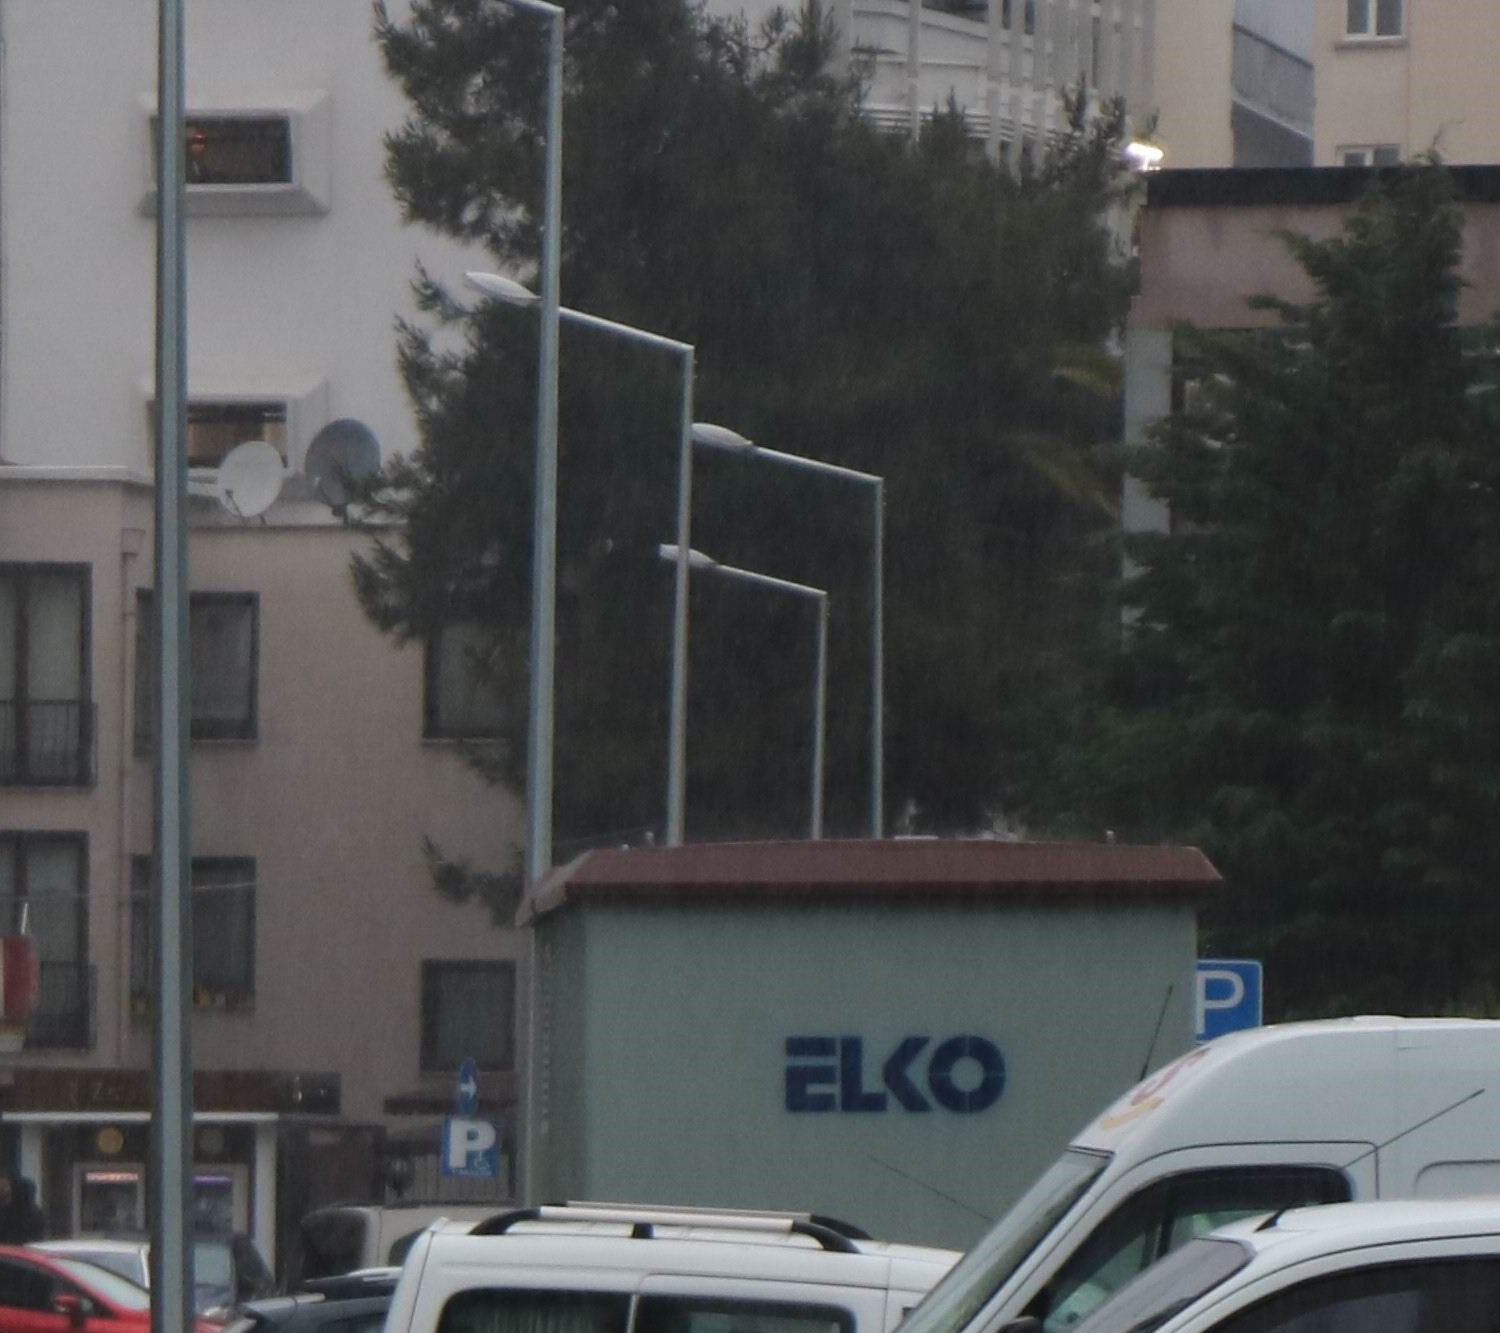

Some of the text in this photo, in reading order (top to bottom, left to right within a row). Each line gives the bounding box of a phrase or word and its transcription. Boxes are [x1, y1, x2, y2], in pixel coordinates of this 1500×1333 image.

[1195, 970, 1245, 1034] P
[785, 1035, 1006, 1115] ELKO
[449, 1119, 497, 1169] P
